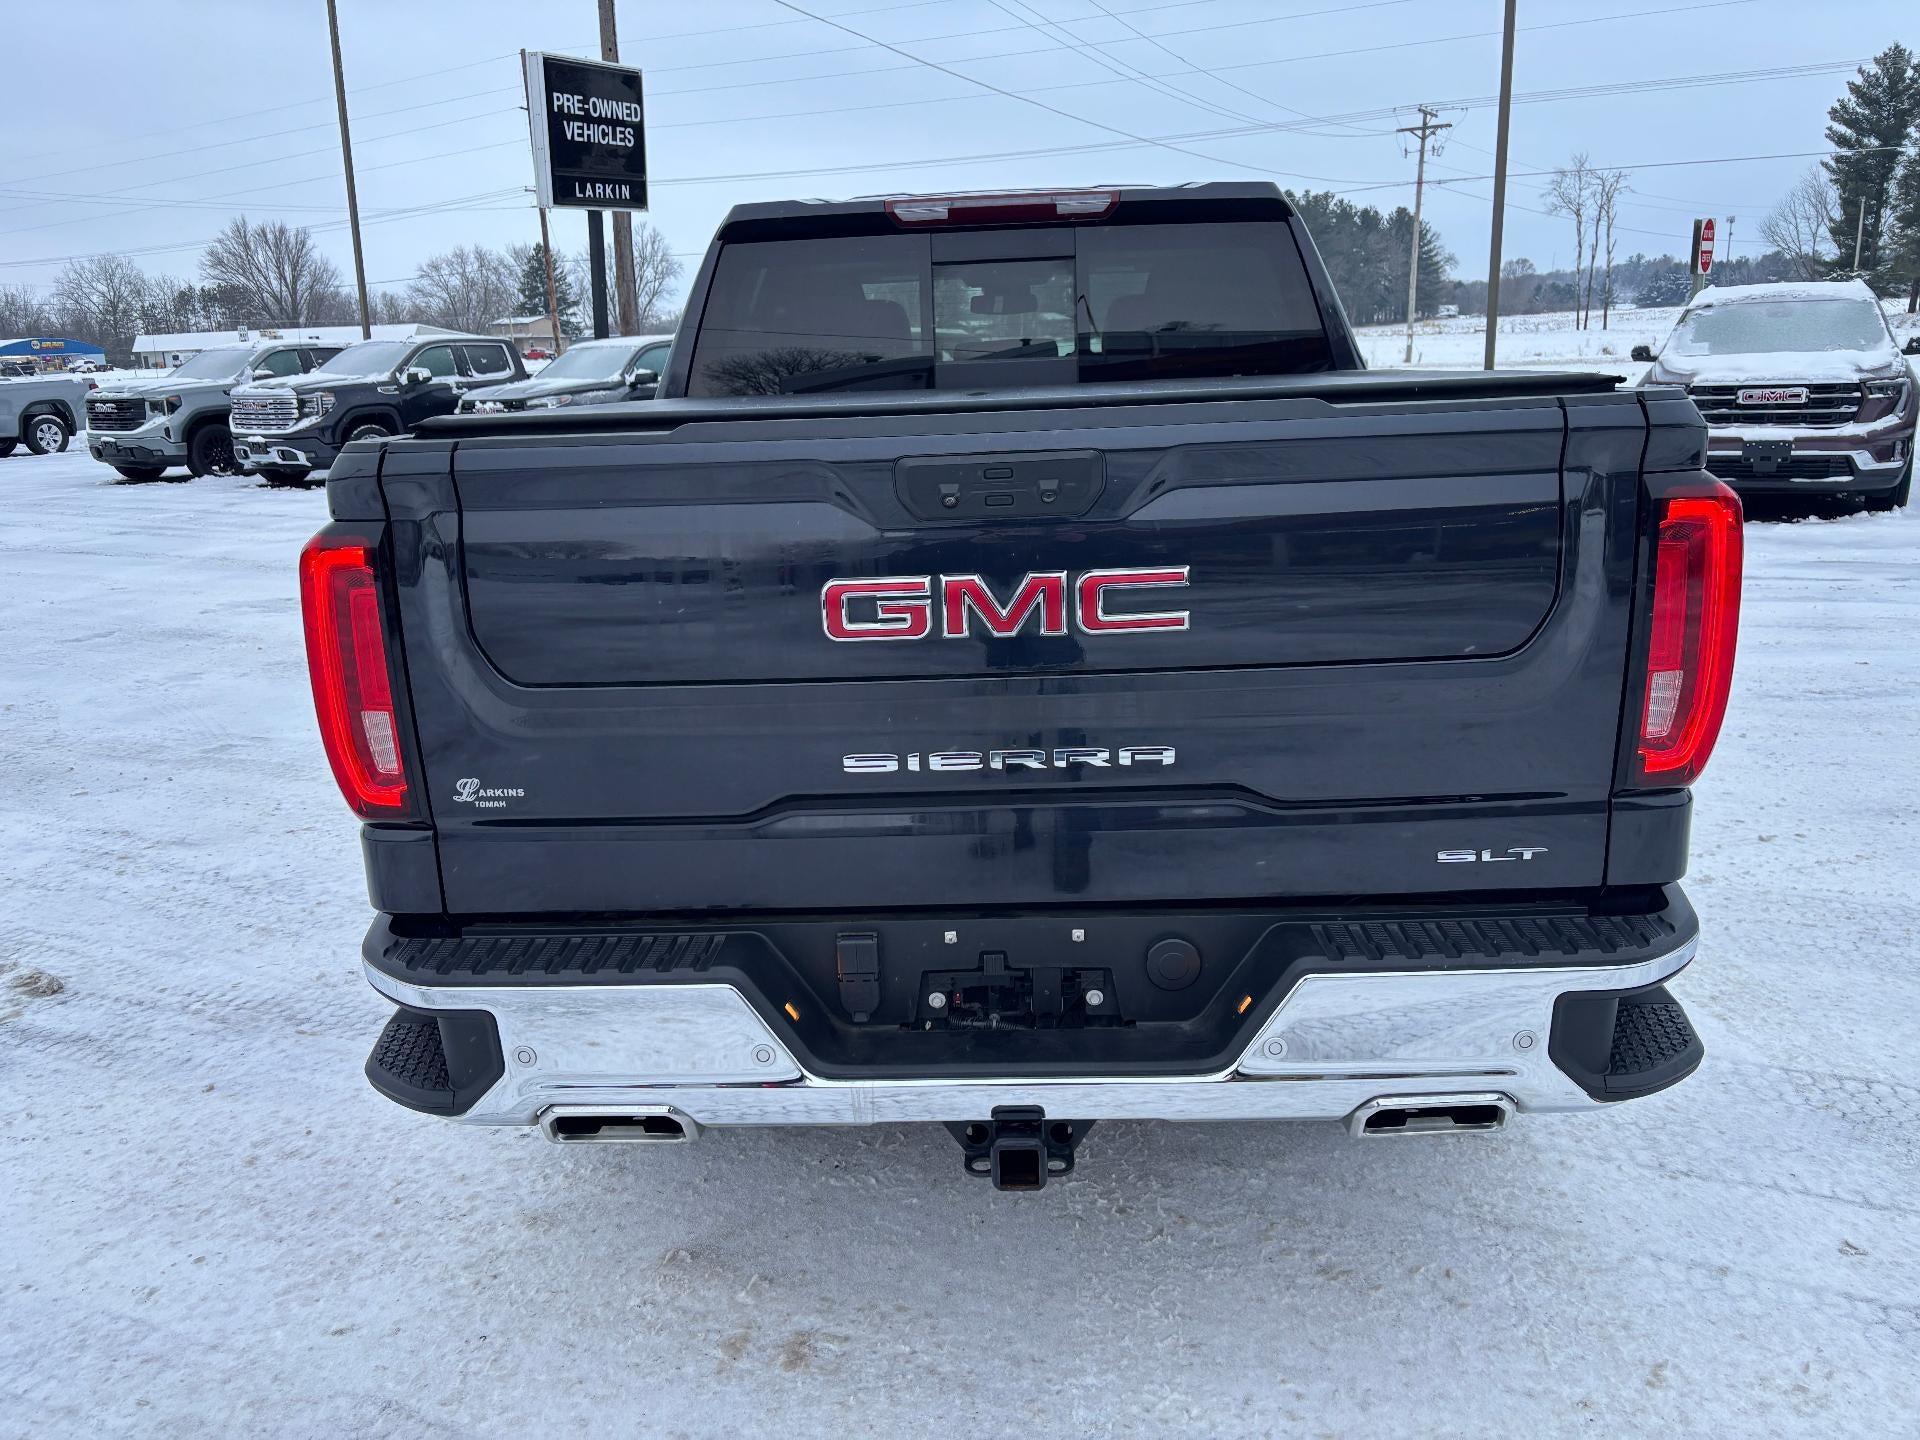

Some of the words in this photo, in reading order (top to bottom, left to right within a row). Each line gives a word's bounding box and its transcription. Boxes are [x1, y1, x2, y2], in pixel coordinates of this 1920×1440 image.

[553, 92, 641, 122] PRE-OWNED
[563, 120, 635, 148] VEHICLES
[575, 182, 631, 200] LARKIN
[1743, 389, 1803, 402] GMC
[821, 565, 1191, 642] GMC
[842, 745, 1177, 773] SIERRA
[453, 777, 526, 802] LARKINS
[1436, 847, 1549, 863] SLT
